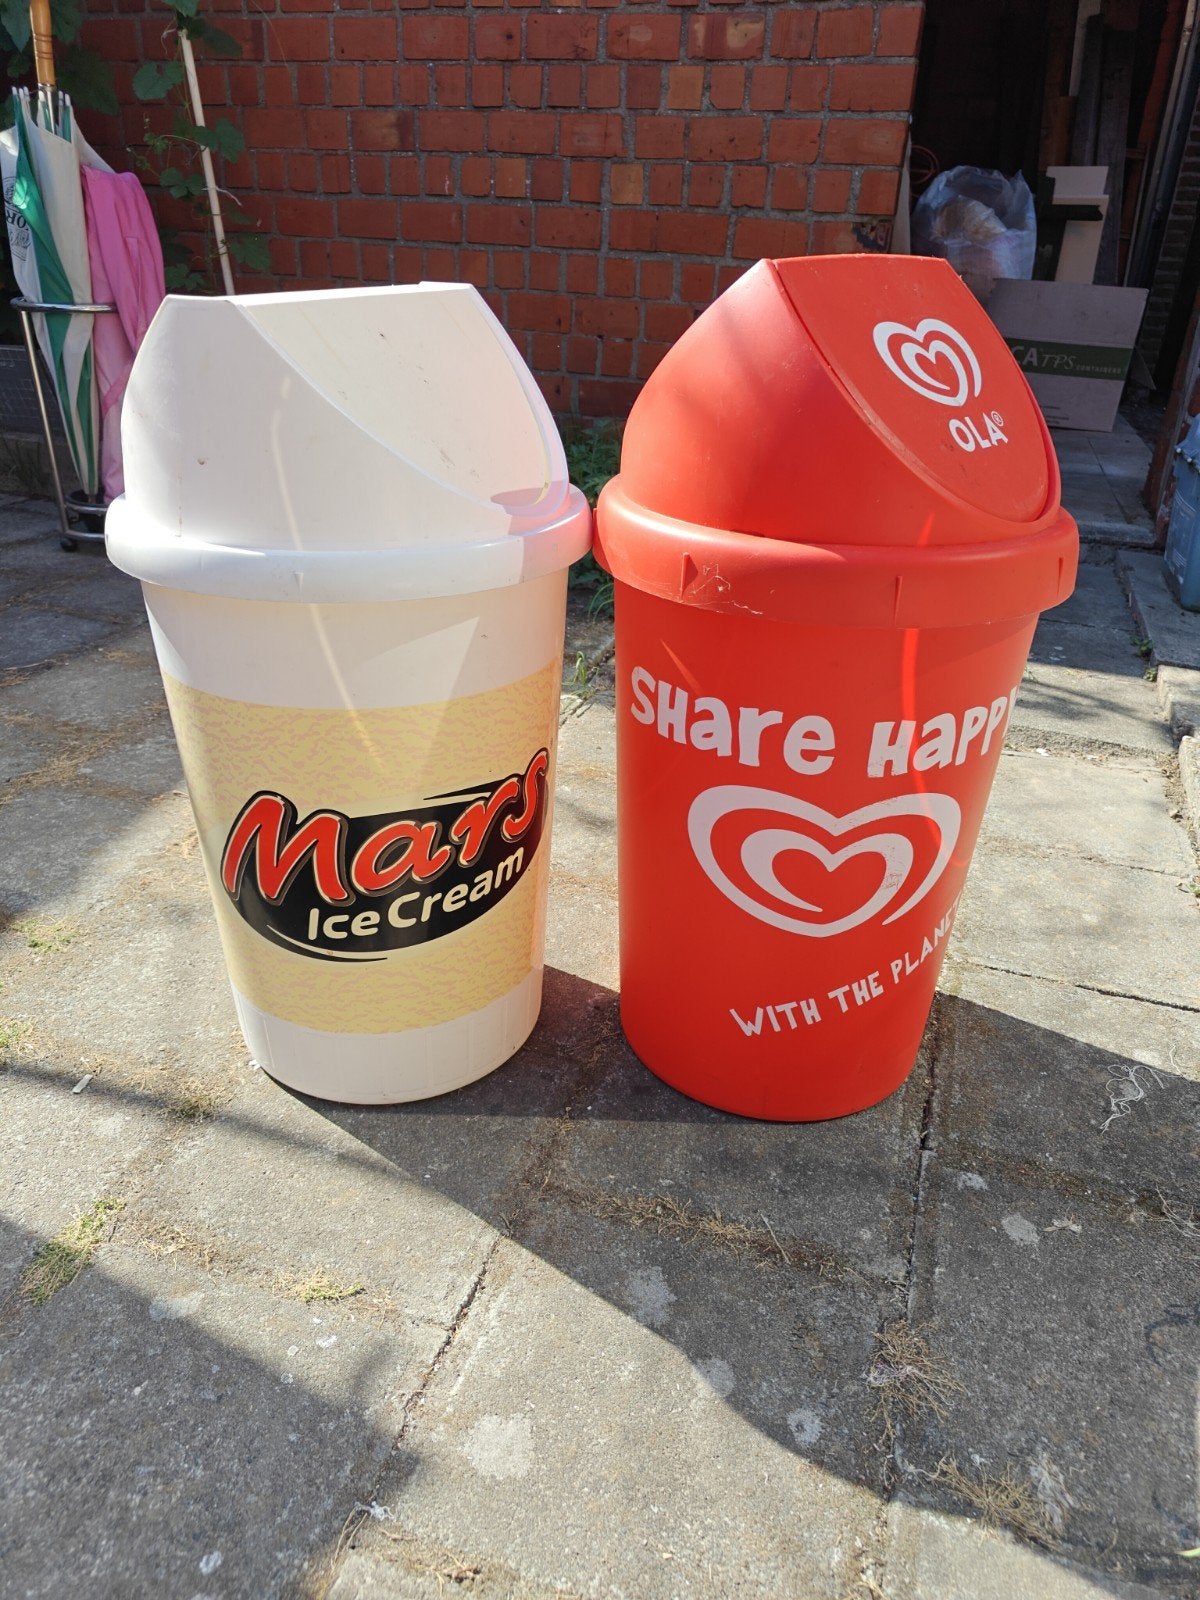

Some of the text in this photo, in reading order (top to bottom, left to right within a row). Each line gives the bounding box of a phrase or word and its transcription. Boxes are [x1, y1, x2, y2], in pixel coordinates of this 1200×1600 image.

[221, 748, 549, 906] Mars
[307, 846, 525, 941] Ice Cream
[729, 998, 822, 1038] WITH
[827, 970, 885, 1014] THE
